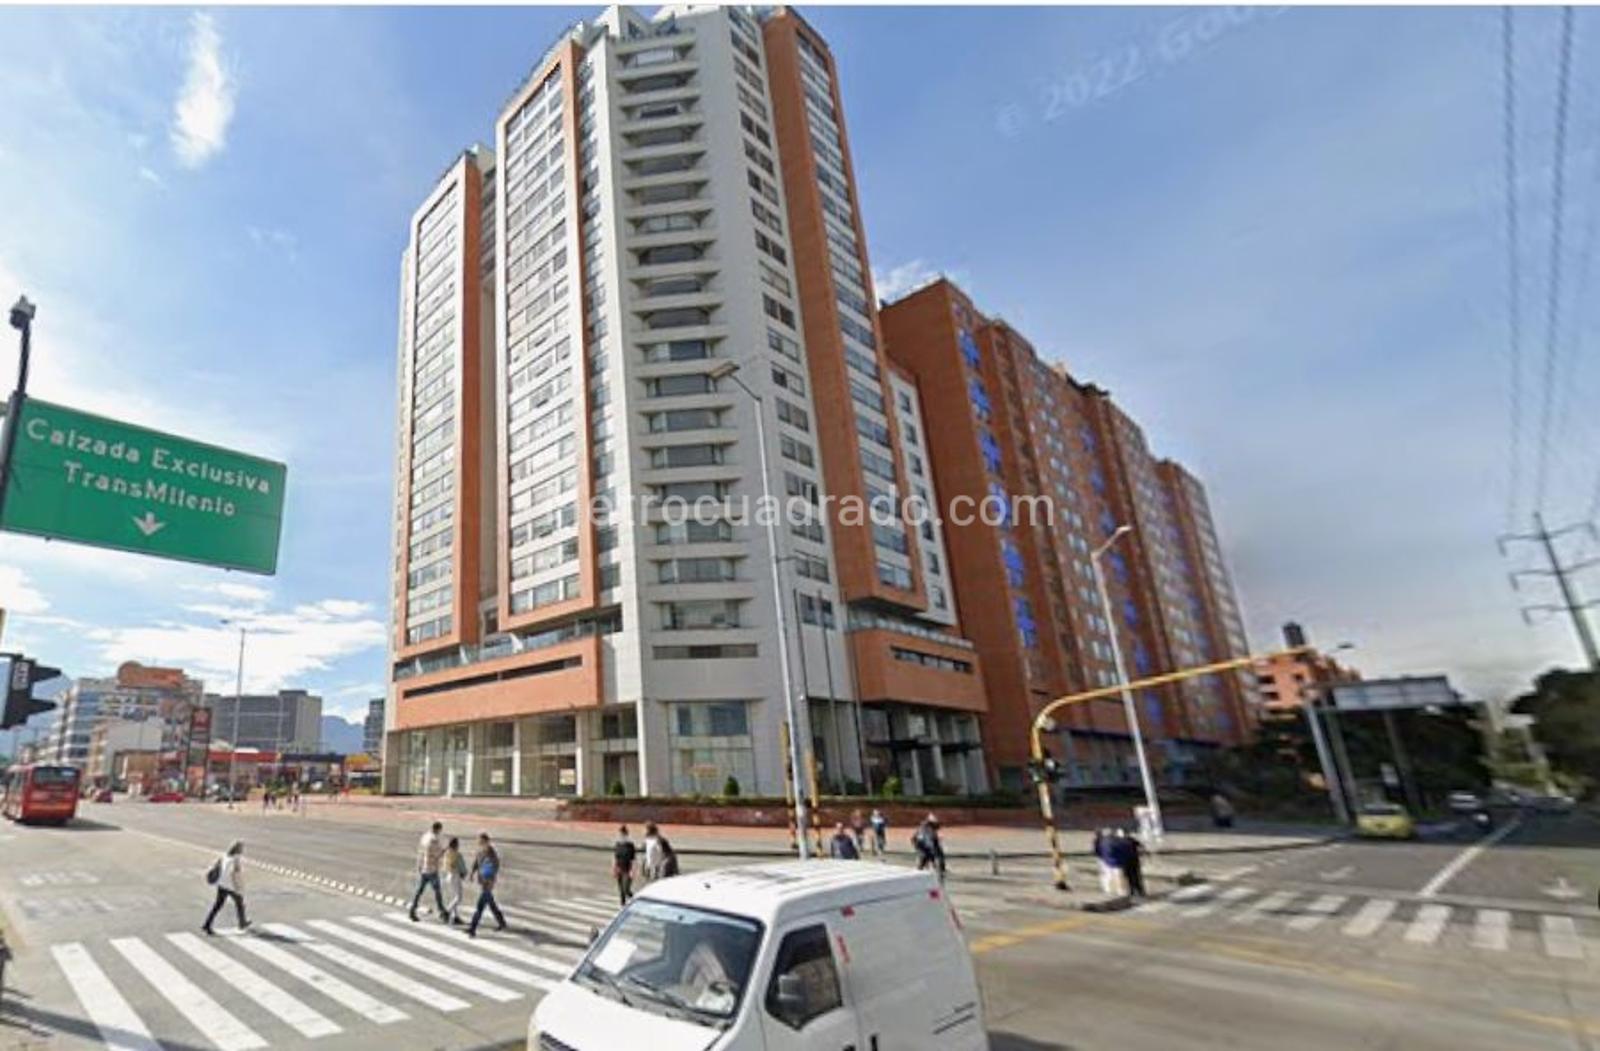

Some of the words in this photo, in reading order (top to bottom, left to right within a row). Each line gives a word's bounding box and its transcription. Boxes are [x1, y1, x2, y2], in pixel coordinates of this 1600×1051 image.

[26, 418, 140, 463] Calzada
[151, 448, 270, 495] Exclusiva
[64, 460, 236, 517] TransMilenio
